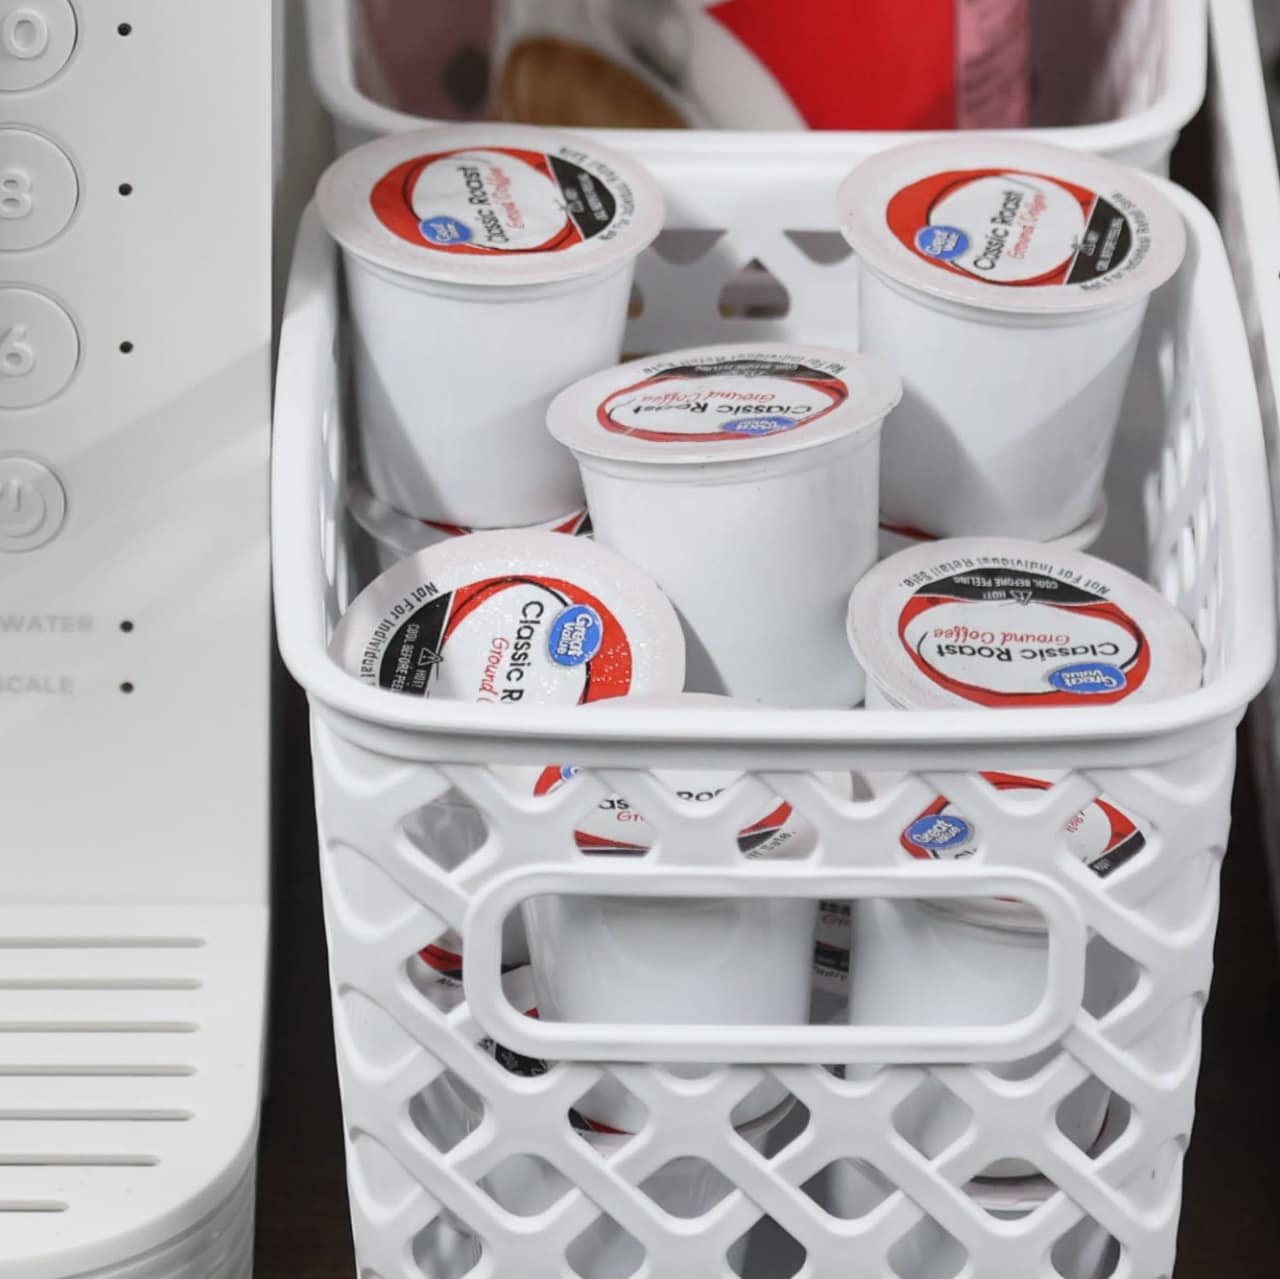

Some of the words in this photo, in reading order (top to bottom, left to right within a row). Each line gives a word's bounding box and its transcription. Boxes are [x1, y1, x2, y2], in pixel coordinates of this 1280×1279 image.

[457, 166, 491, 206] Roast
[990, 190, 1024, 226] Roast
[973, 227, 1009, 271] Classic
[715, 402, 812, 415] Classic
[978, 556, 1055, 576] Individual
[410, 581, 439, 602] Not
[1084, 577, 1112, 596] Not
[390, 597, 415, 620] For
[506, 601, 544, 682] Classic
[556, 622, 576, 655] Value
[567, 613, 593, 657] Great
[933, 625, 995, 645] Coffee
[1000, 630, 1070, 647] Ground
[360, 619, 396, 678] Individual
[936, 643, 1012, 663] Roast
[1020, 641, 1120, 662] Classic
[479, 636, 510, 696] Ground
